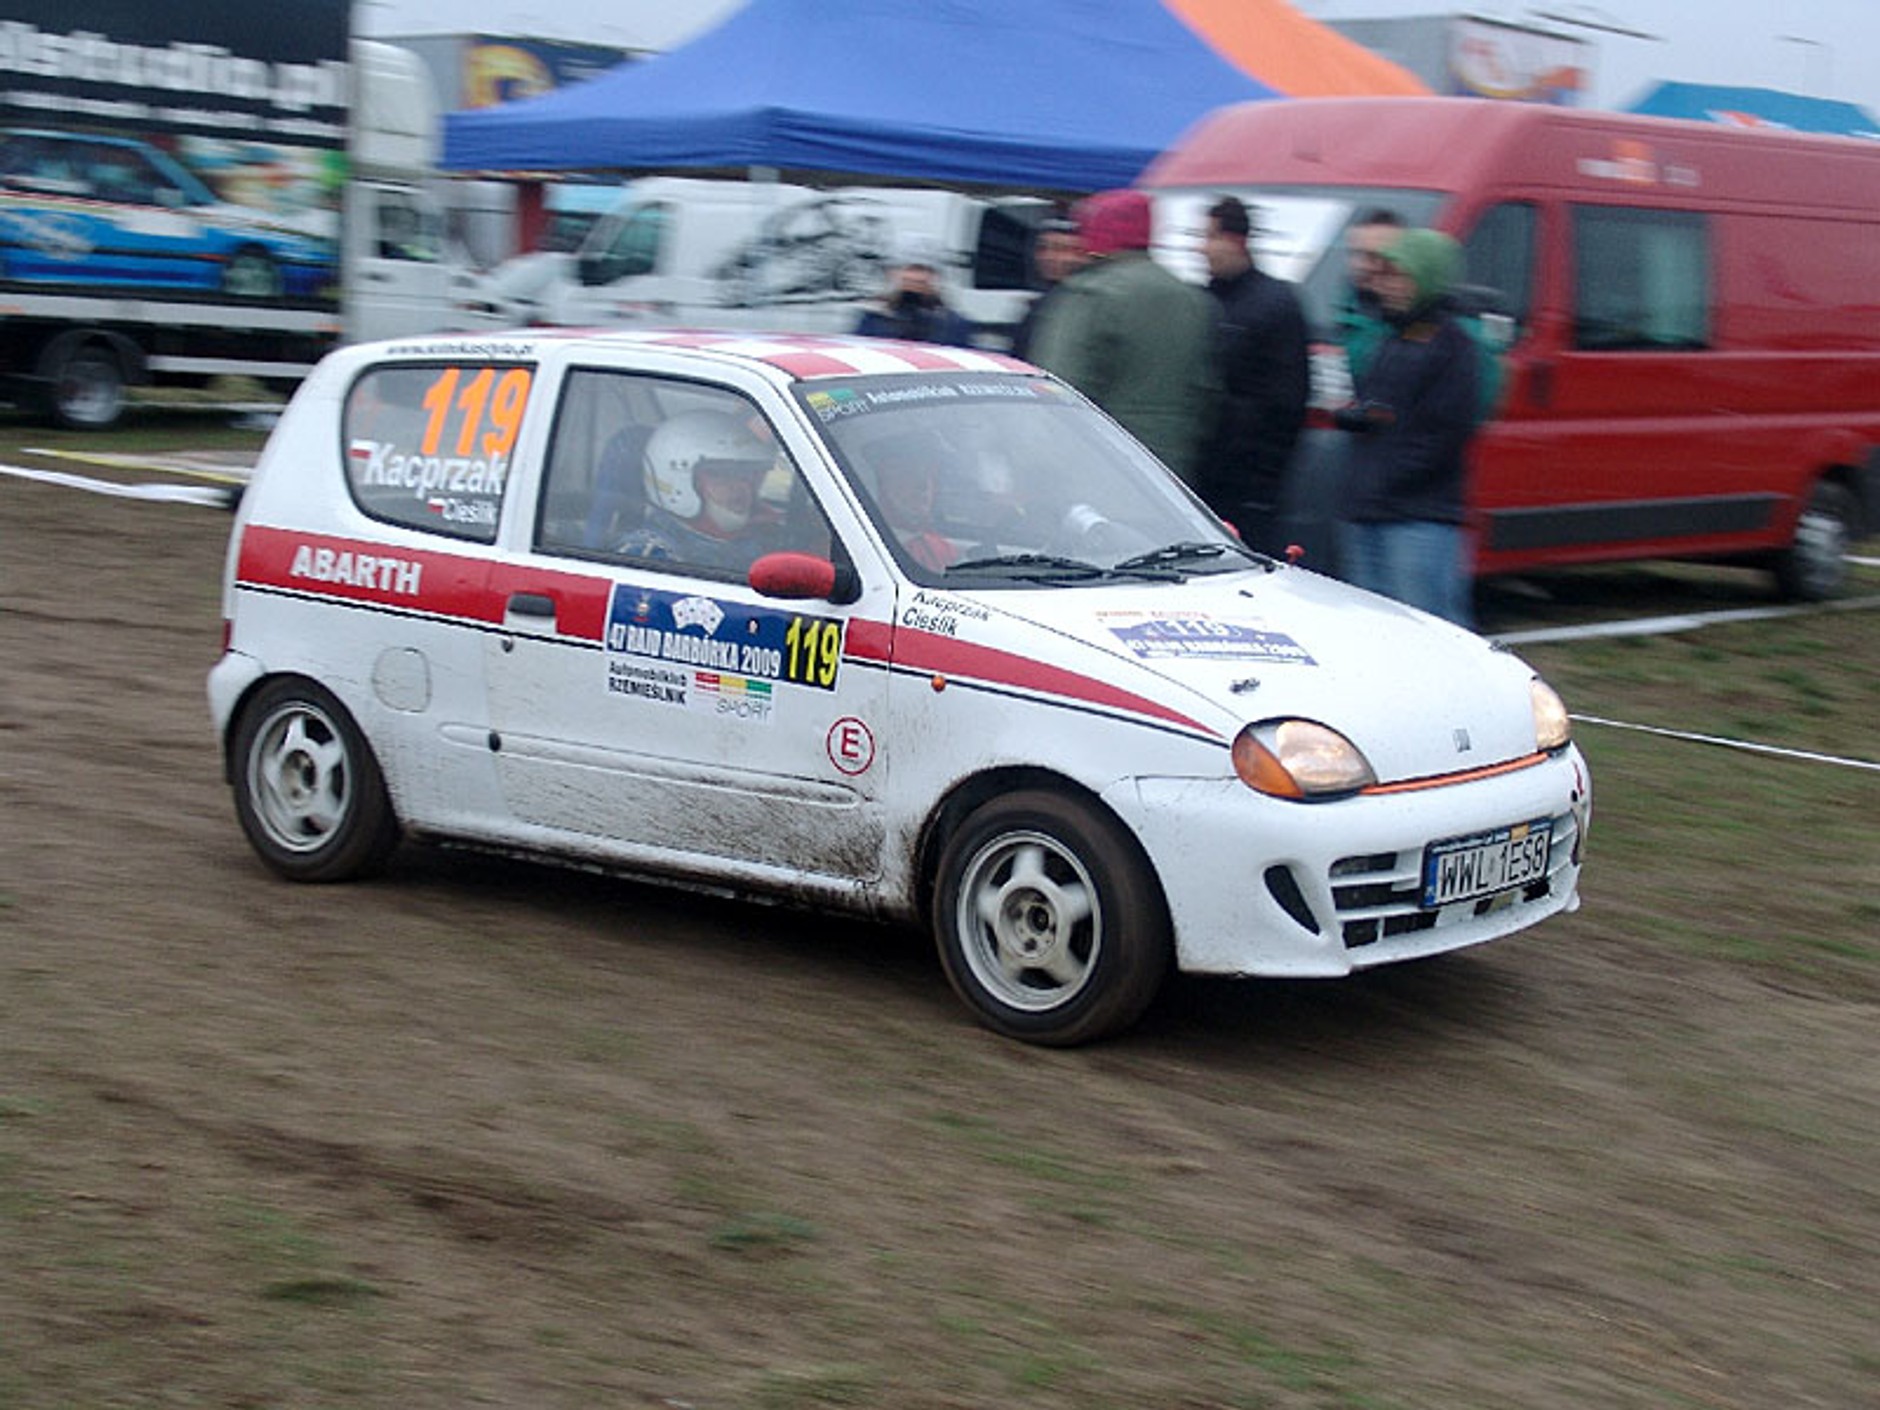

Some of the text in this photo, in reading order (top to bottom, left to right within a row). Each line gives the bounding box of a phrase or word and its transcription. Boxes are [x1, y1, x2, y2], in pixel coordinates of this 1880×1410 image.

[421, 366, 533, 458] 119
[363, 443, 508, 500] Kacprzak
[289, 545, 422, 595] ABARTH
[740, 645, 782, 678] 2009
[786, 617, 840, 687] 119
[841, 726, 860, 759] E
[1440, 834, 1545, 898] WWL 1ES8
